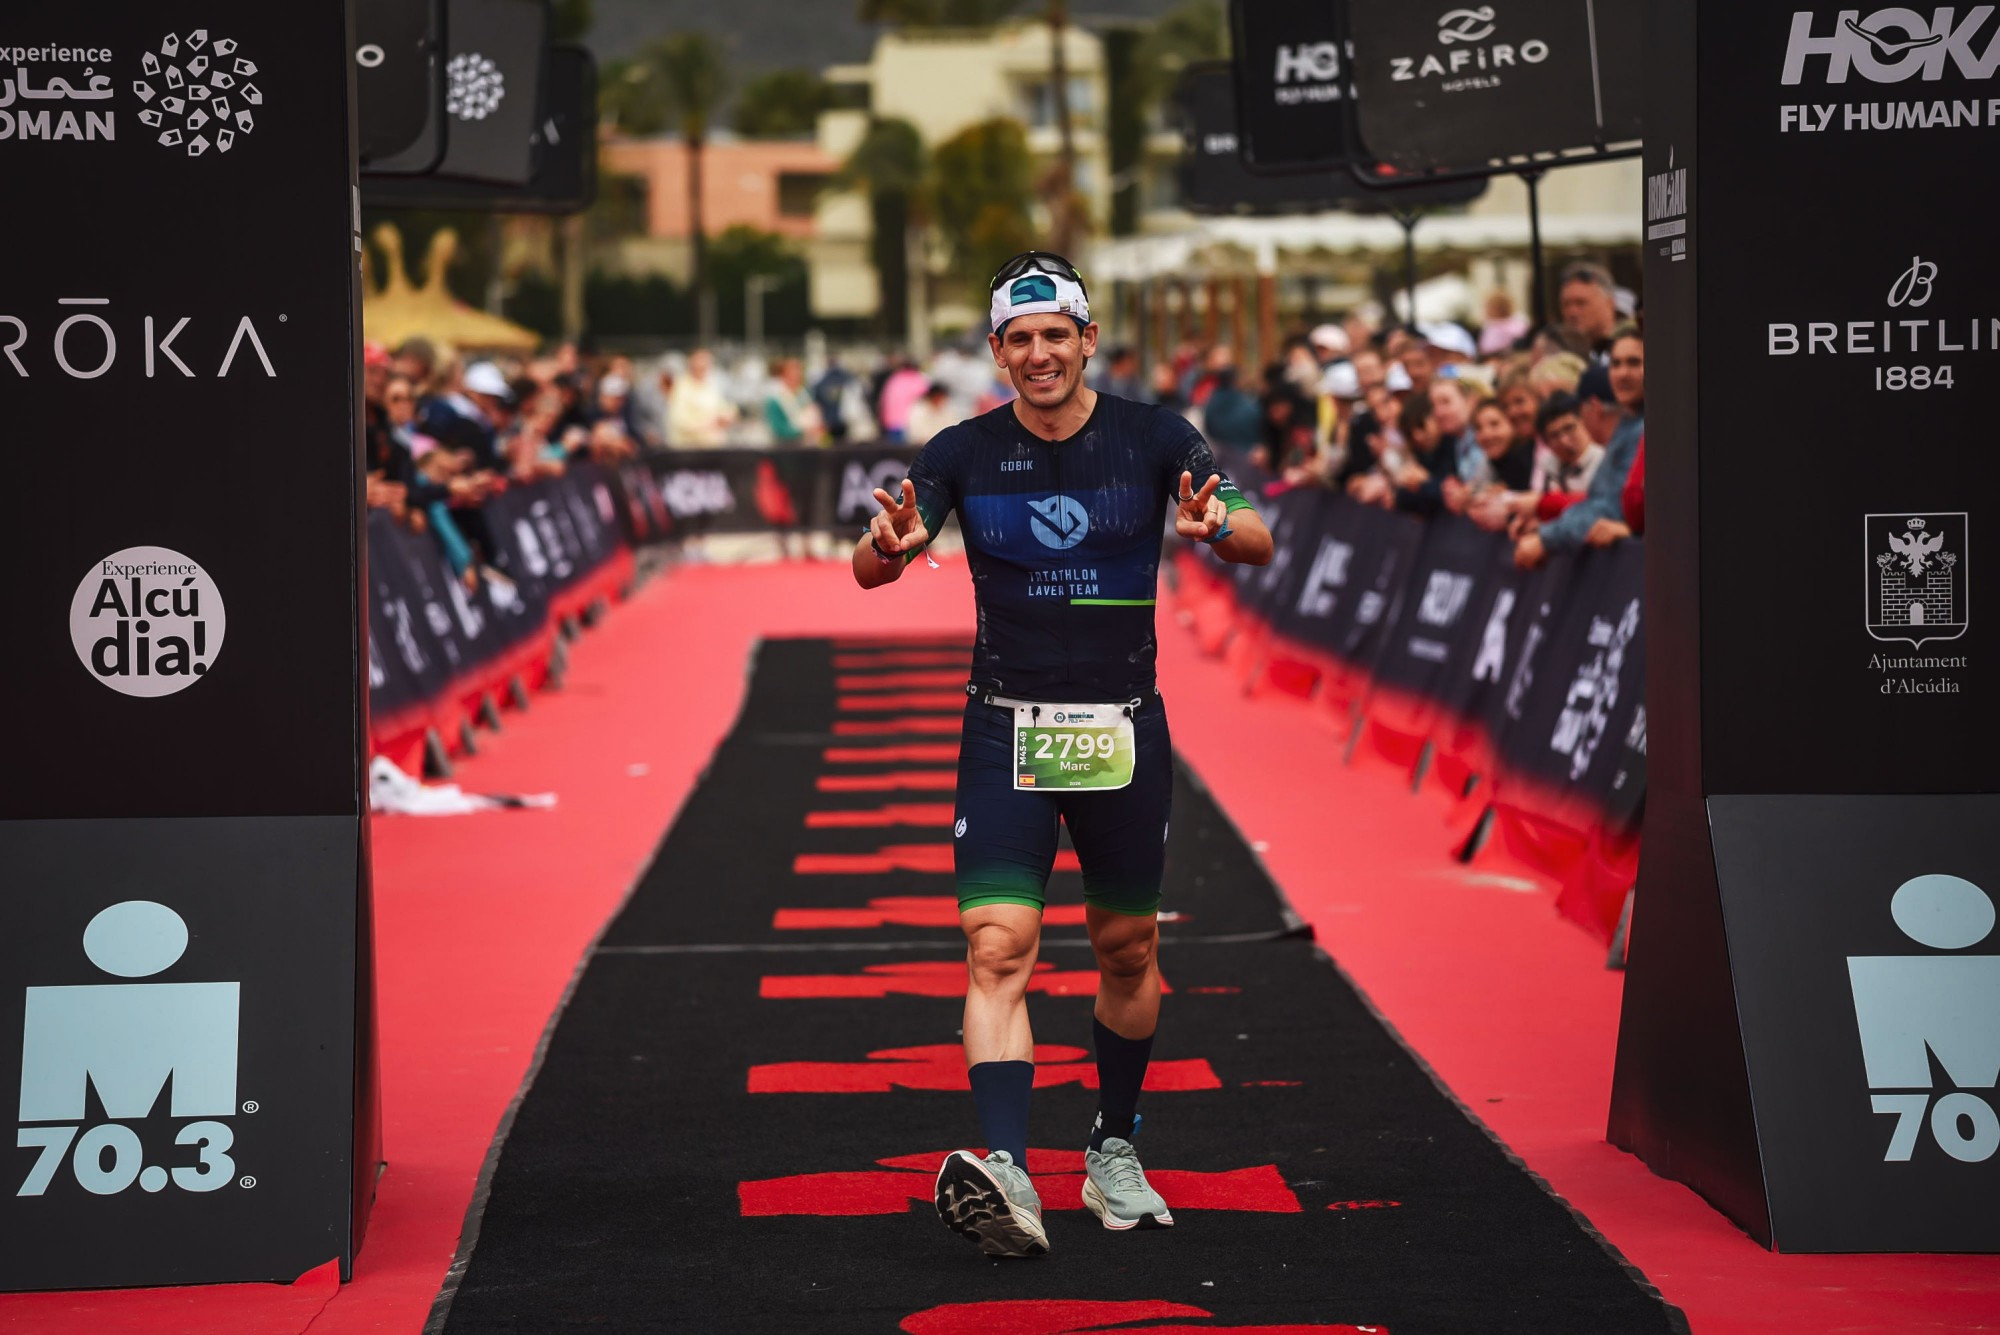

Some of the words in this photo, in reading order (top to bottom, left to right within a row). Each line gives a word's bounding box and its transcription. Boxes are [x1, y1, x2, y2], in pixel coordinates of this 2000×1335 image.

[1781, 5, 2000, 85] HOK
[1780, 104, 1837, 133] FLY
[1844, 99, 1980, 131] HUMAN
[1876, 365, 1955, 391] 1884
[1000, 460, 1034, 471] GOBIK
[101, 560, 197, 580] Experience
[89, 577, 199, 618] Alcú
[1028, 586, 1064, 596] LAVER
[1069, 584, 1099, 596] TEAM
[91, 620, 207, 677] dia!
[1867, 653, 1967, 673] Ajuntament
[1880, 678, 1960, 695] d'Alcúdia
[1019, 731, 1027, 765] M45-49
[1034, 733, 1115, 759] 2799
[1060, 761, 1090, 771] Marc
[16, 1120, 236, 1197] 70.3
